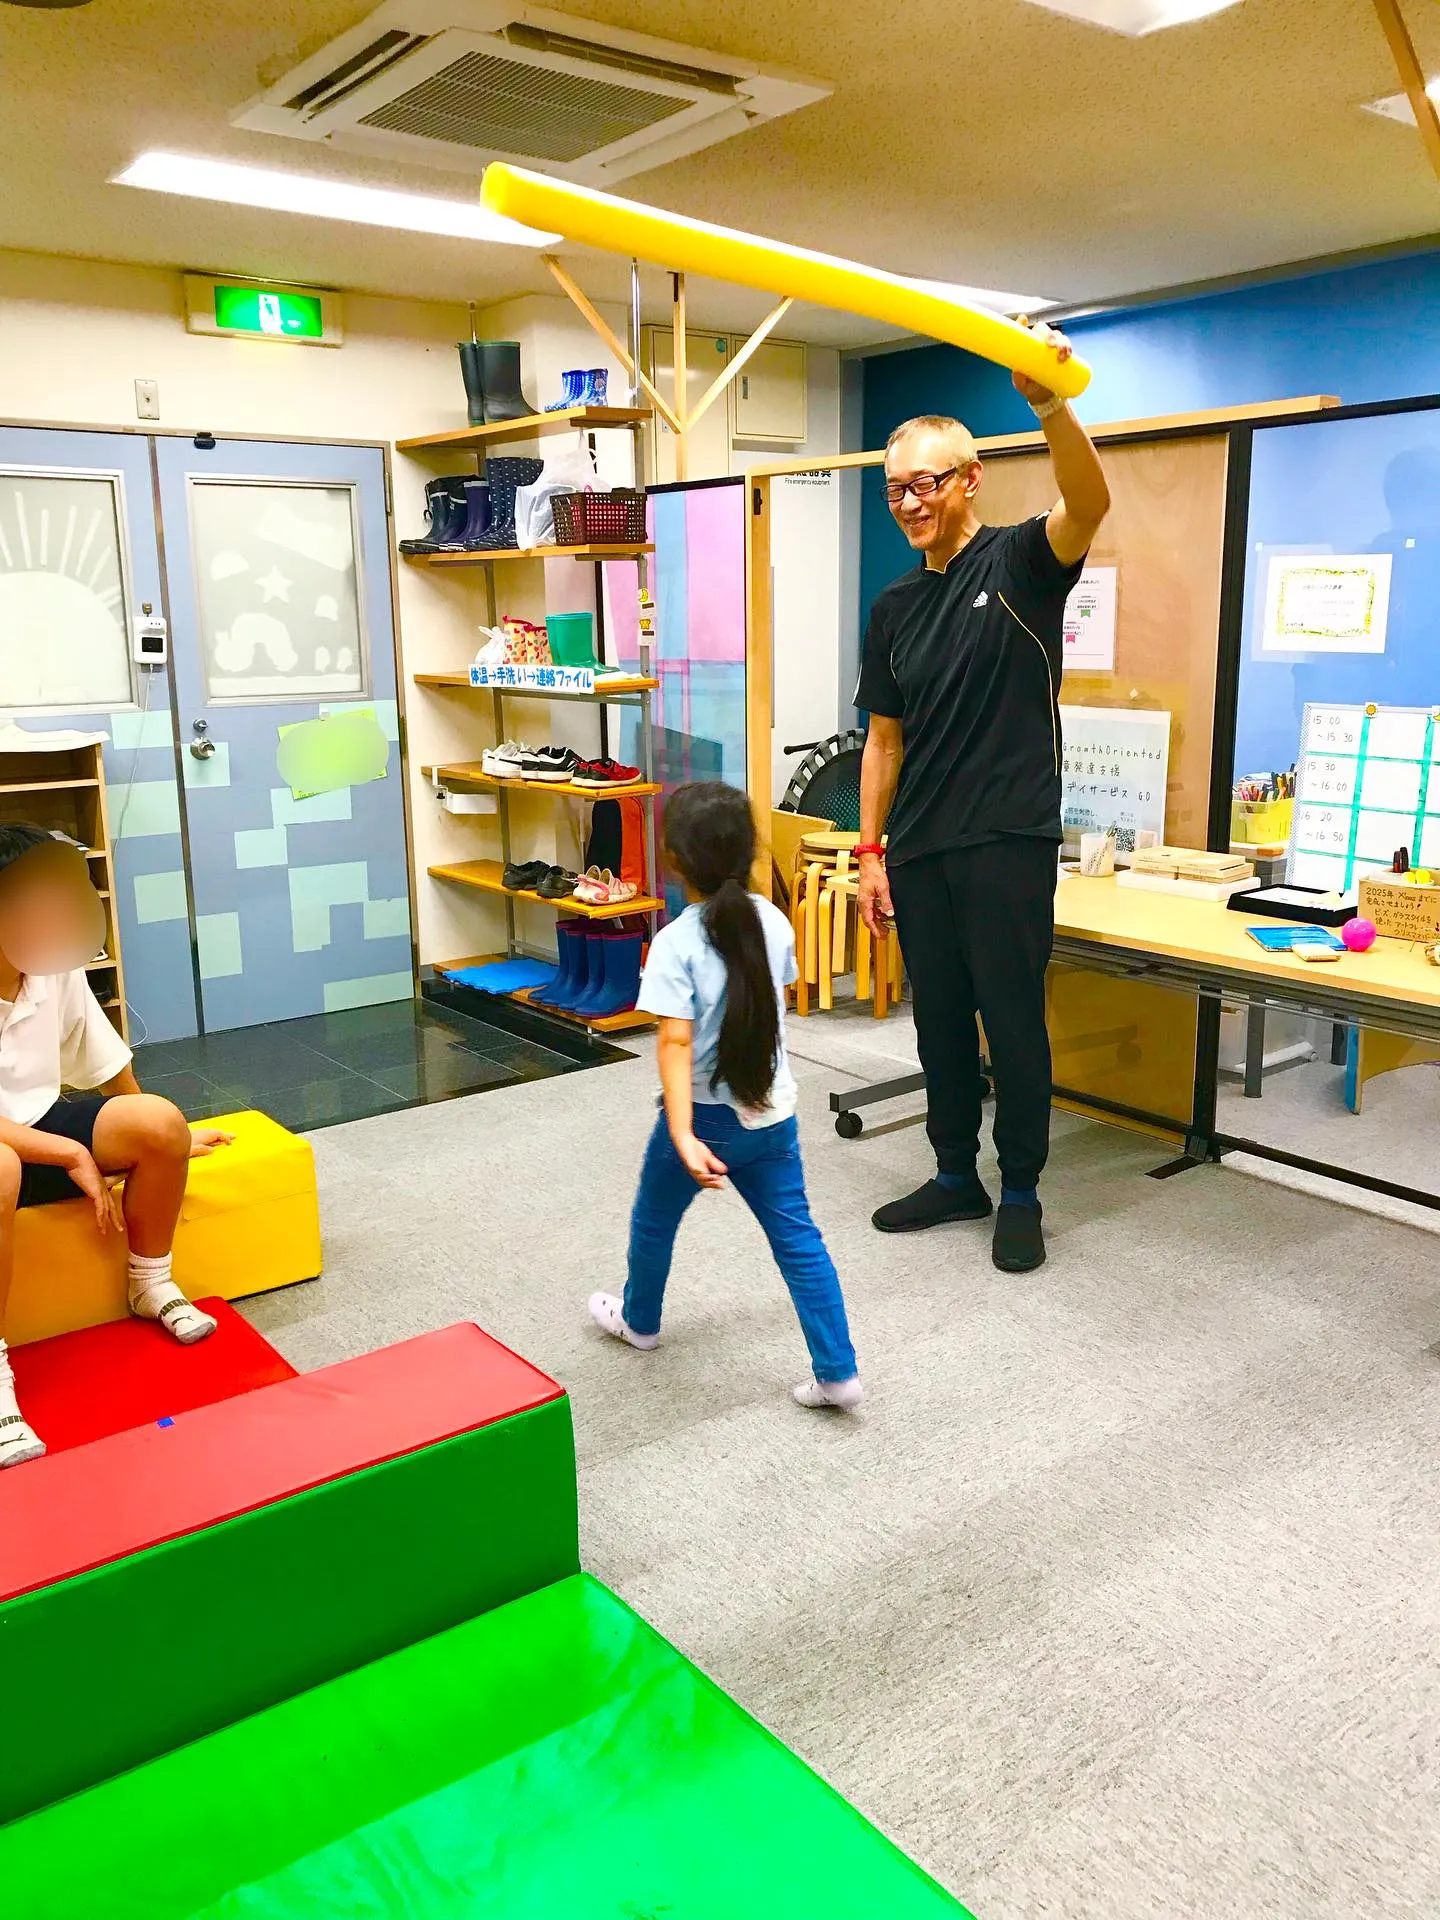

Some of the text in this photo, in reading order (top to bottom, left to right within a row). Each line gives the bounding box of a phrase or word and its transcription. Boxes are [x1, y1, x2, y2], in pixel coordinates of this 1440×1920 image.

[471, 666, 592, 688] 体温 手洗い 連絡ファイル
